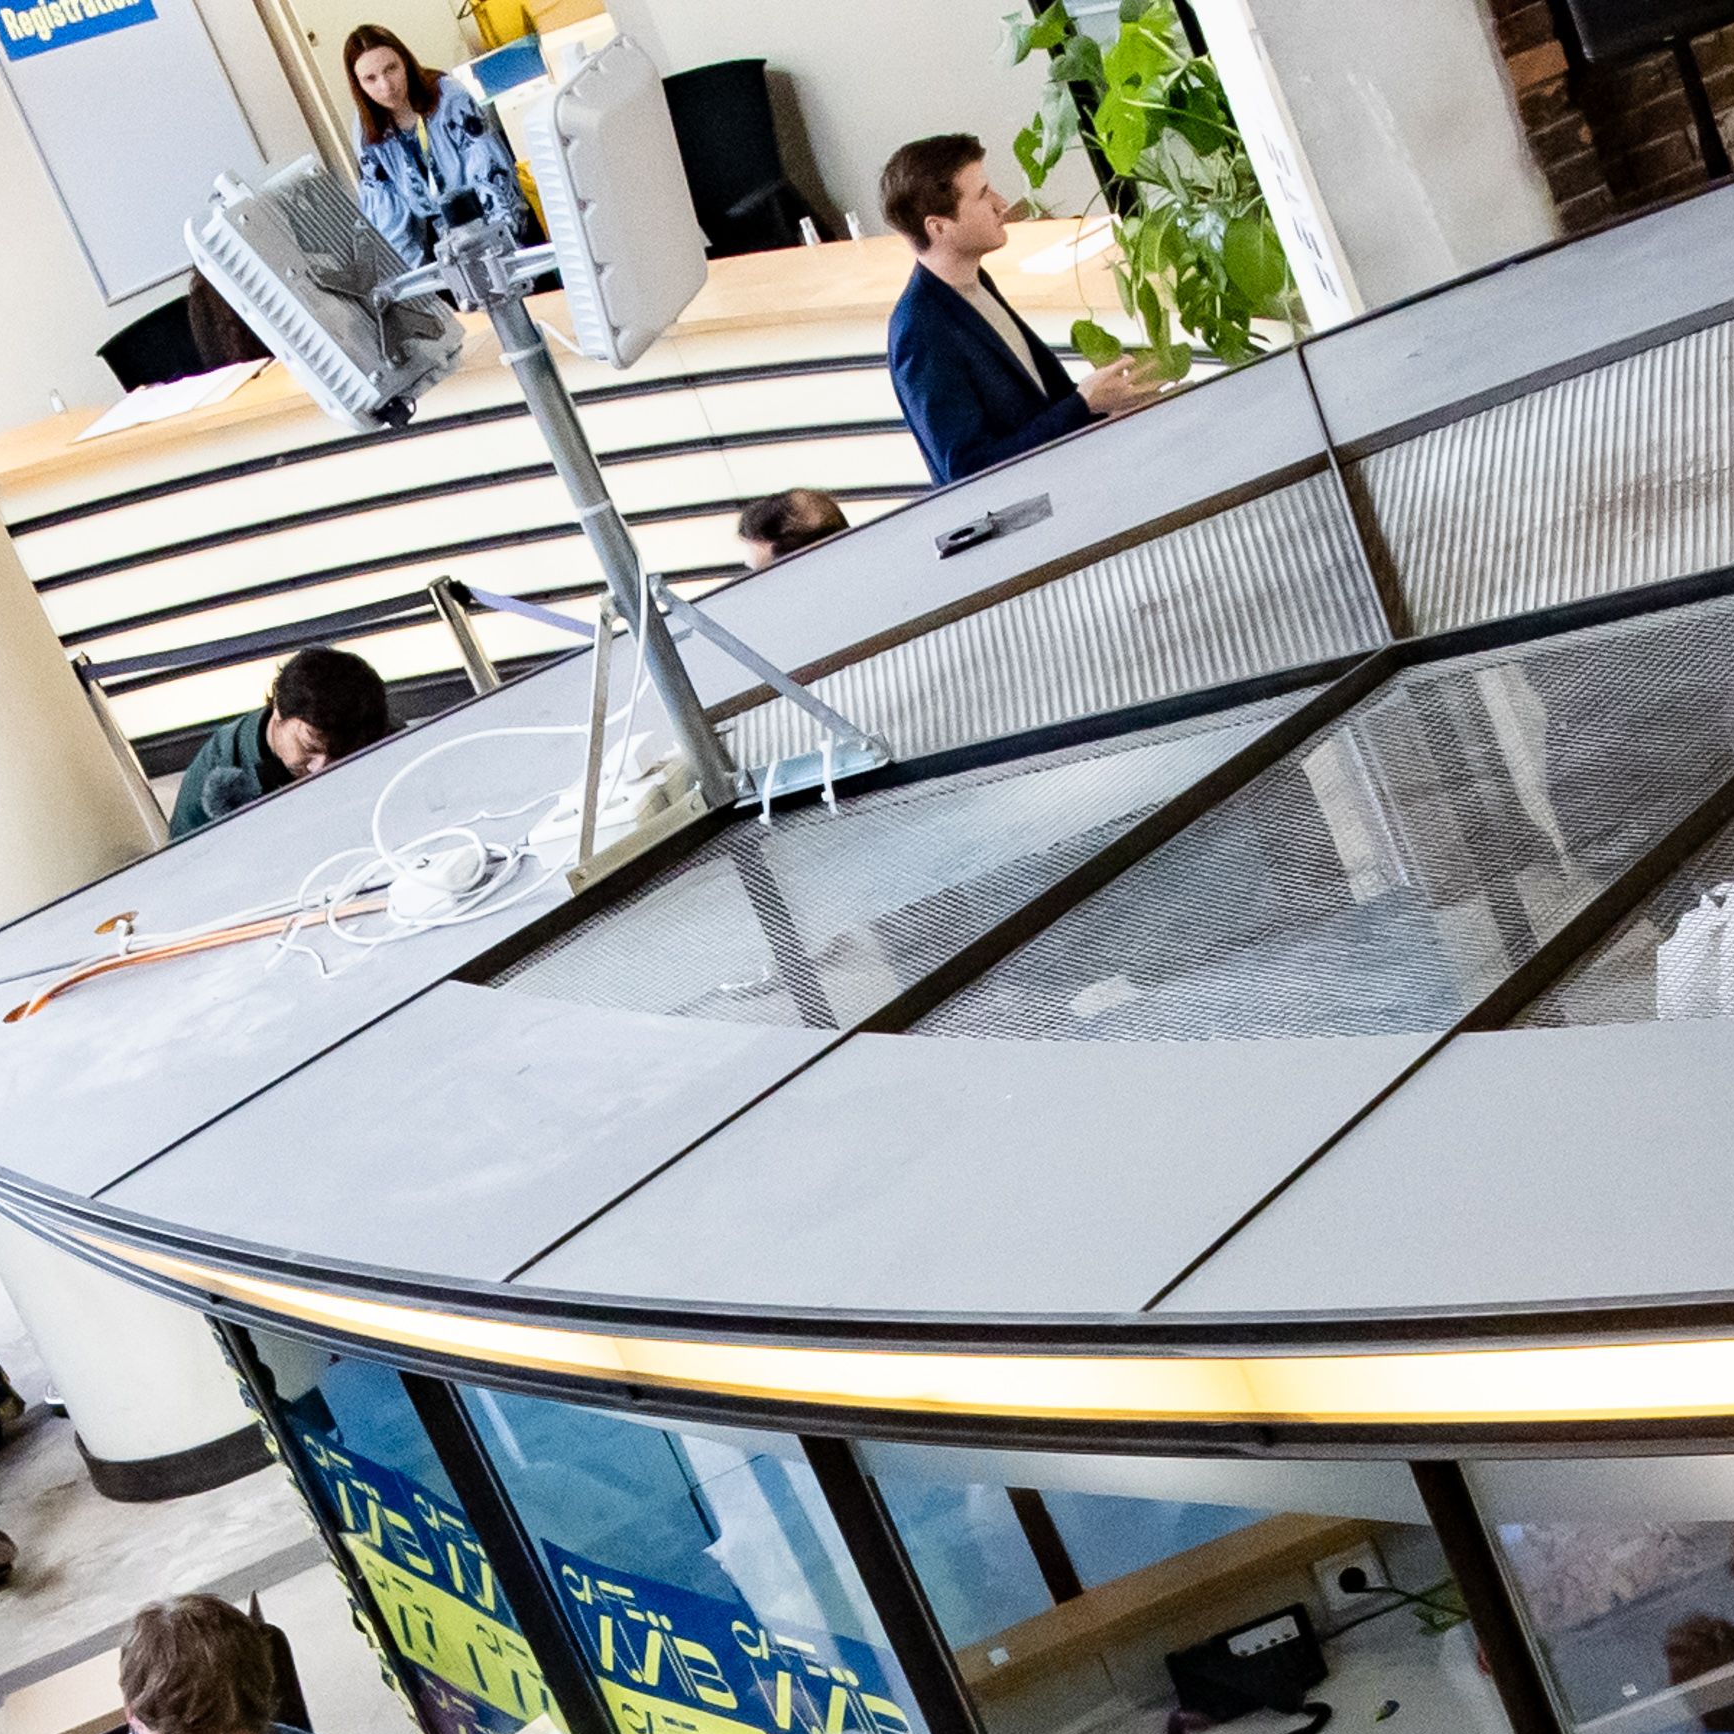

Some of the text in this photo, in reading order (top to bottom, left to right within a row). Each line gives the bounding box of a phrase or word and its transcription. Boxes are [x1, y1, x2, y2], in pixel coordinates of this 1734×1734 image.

[0, 0, 143, 41] Registra
[561, 1563, 647, 1624] CAFE
[730, 1619, 831, 1680] CAFE
